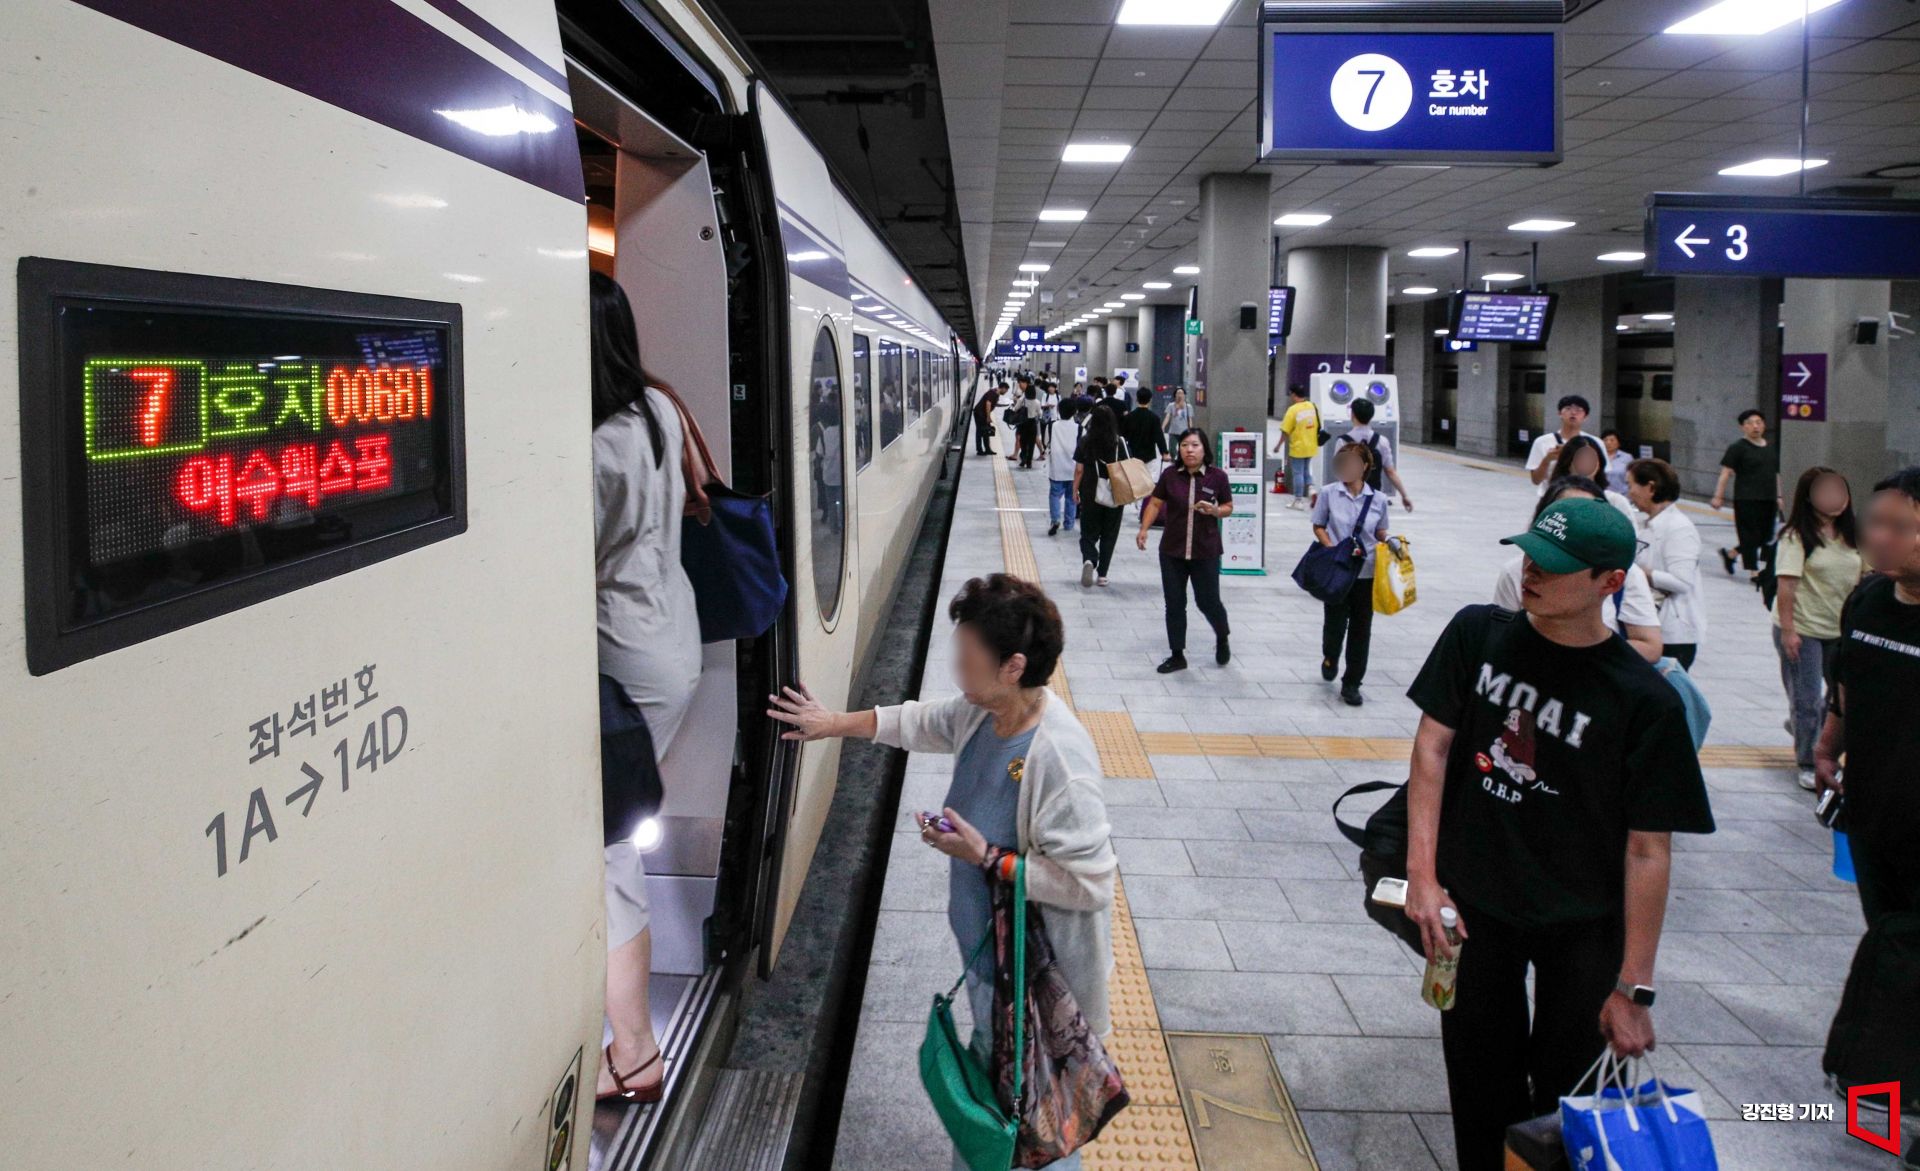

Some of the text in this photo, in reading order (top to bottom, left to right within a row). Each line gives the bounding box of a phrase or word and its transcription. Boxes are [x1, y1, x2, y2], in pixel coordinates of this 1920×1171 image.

[1357, 68, 1490, 115] 7 호차
[1428, 103, 1489, 116] Car number
[1725, 224, 1749, 261] 3
[132, 364, 433, 445] 7 호차 00681
[1234, 447, 1248, 455] AED
[177, 434, 391, 525] 여수엑스포
[1238, 485, 1255, 494] AED
[1552, 511, 1568, 523] The
[1552, 528, 1567, 541] On
[249, 663, 379, 765] 좌석번호
[1475, 662, 1592, 749] MOAI
[205, 705, 409, 878] 1A 14D
